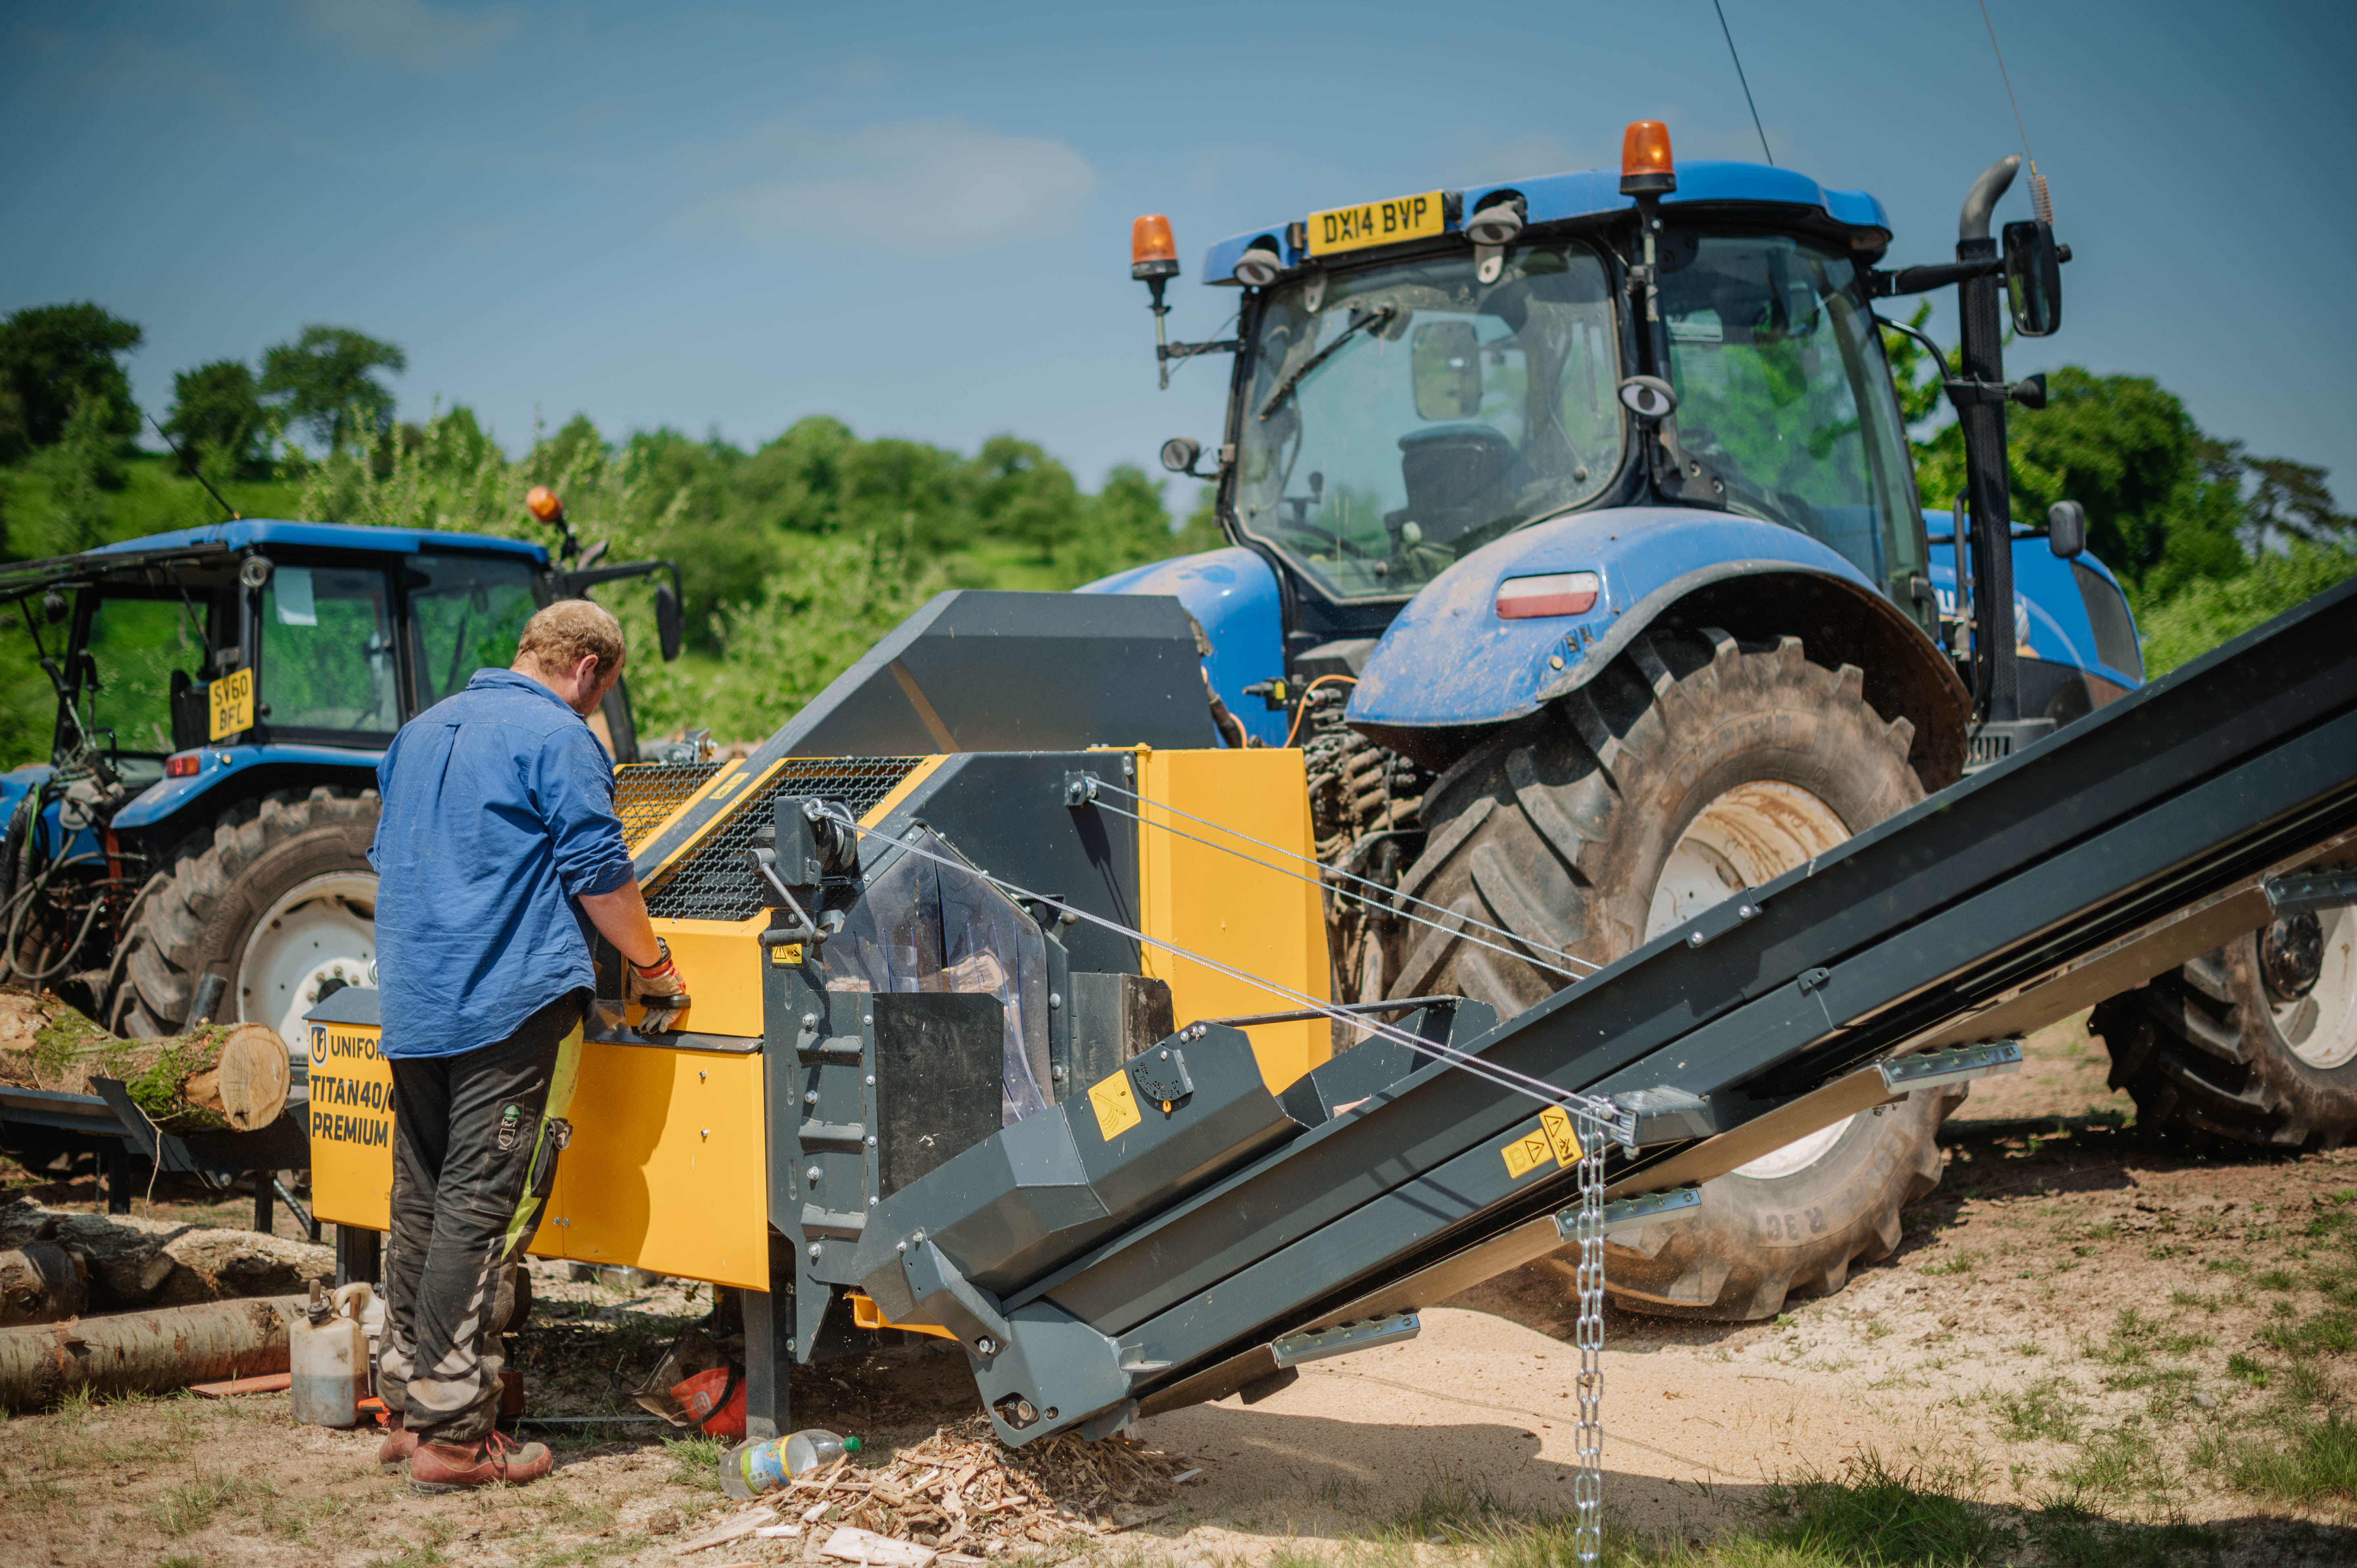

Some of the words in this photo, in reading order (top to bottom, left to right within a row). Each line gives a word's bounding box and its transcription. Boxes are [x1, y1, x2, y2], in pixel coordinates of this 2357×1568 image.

[1323, 207, 1373, 244] DX14
[1382, 197, 1427, 234] BVP
[215, 675, 248, 706] SV60
[219, 702, 244, 731] BFL
[331, 1035, 389, 1061] UNIFOR
[312, 1111, 388, 1148] PREMIUM
[1804, 1206, 1828, 1235] R
